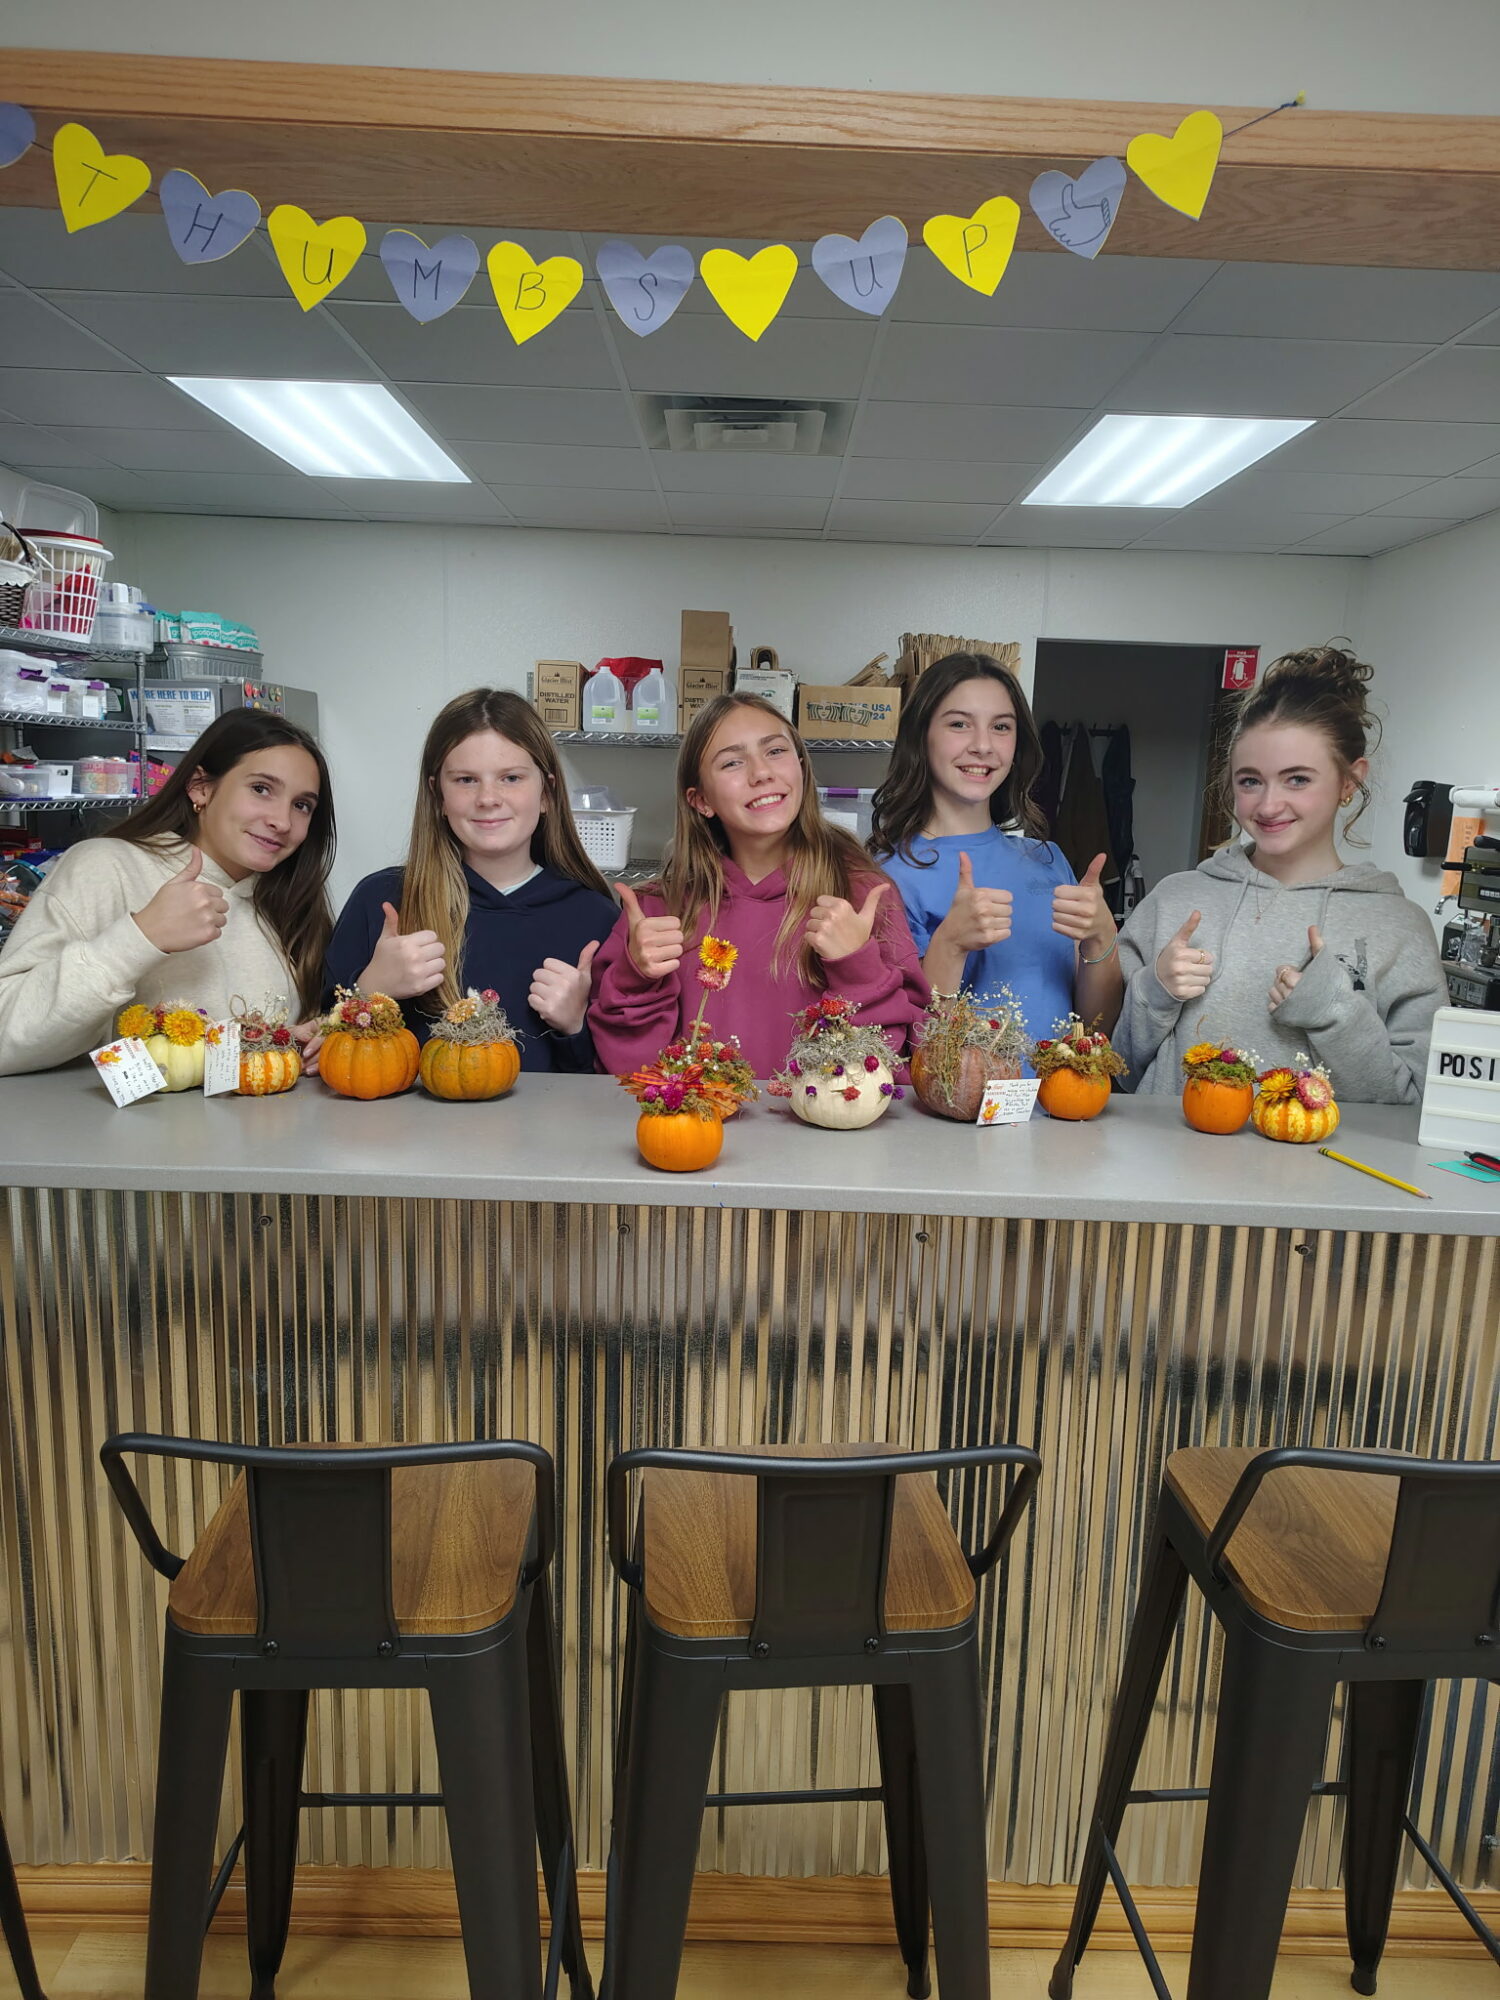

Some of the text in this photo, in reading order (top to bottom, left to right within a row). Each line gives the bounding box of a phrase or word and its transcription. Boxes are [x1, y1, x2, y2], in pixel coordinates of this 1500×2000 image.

[157, 690, 176, 699] HERE
[179, 690, 189, 700] TO
[191, 691, 212, 700] HELP!
[540, 691, 575, 699] DISTILLED
[1440, 1052, 1496, 1081] POSI
